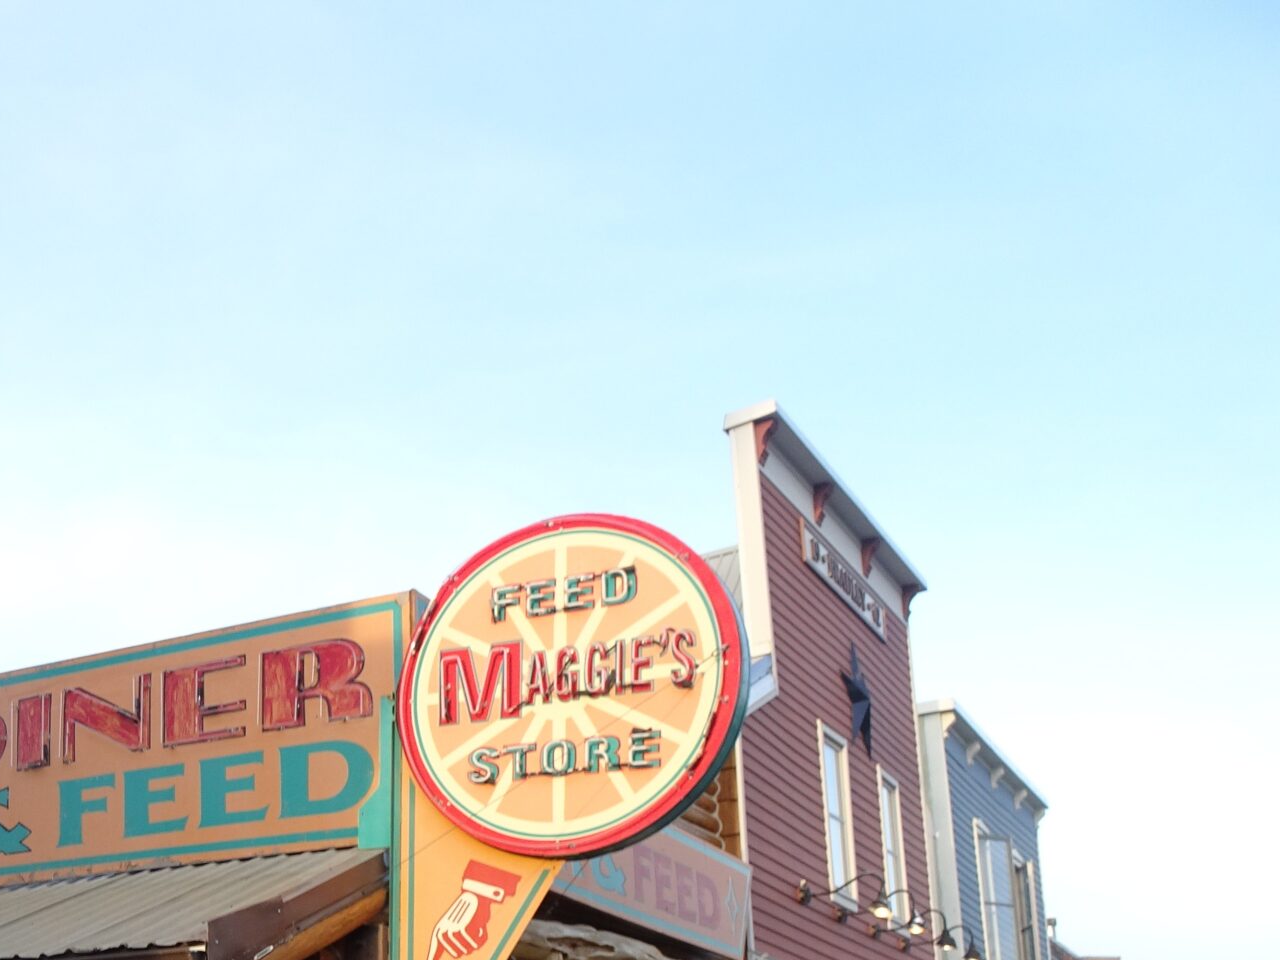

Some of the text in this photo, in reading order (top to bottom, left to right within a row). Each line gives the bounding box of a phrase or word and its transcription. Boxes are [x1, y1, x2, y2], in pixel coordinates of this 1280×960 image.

[490, 565, 638, 623] FEED
[439, 628, 697, 726] MAGGIE'S
[57, 740, 374, 848] FEED
[468, 728, 661, 785] STORE
[632, 845, 719, 931] FEED
